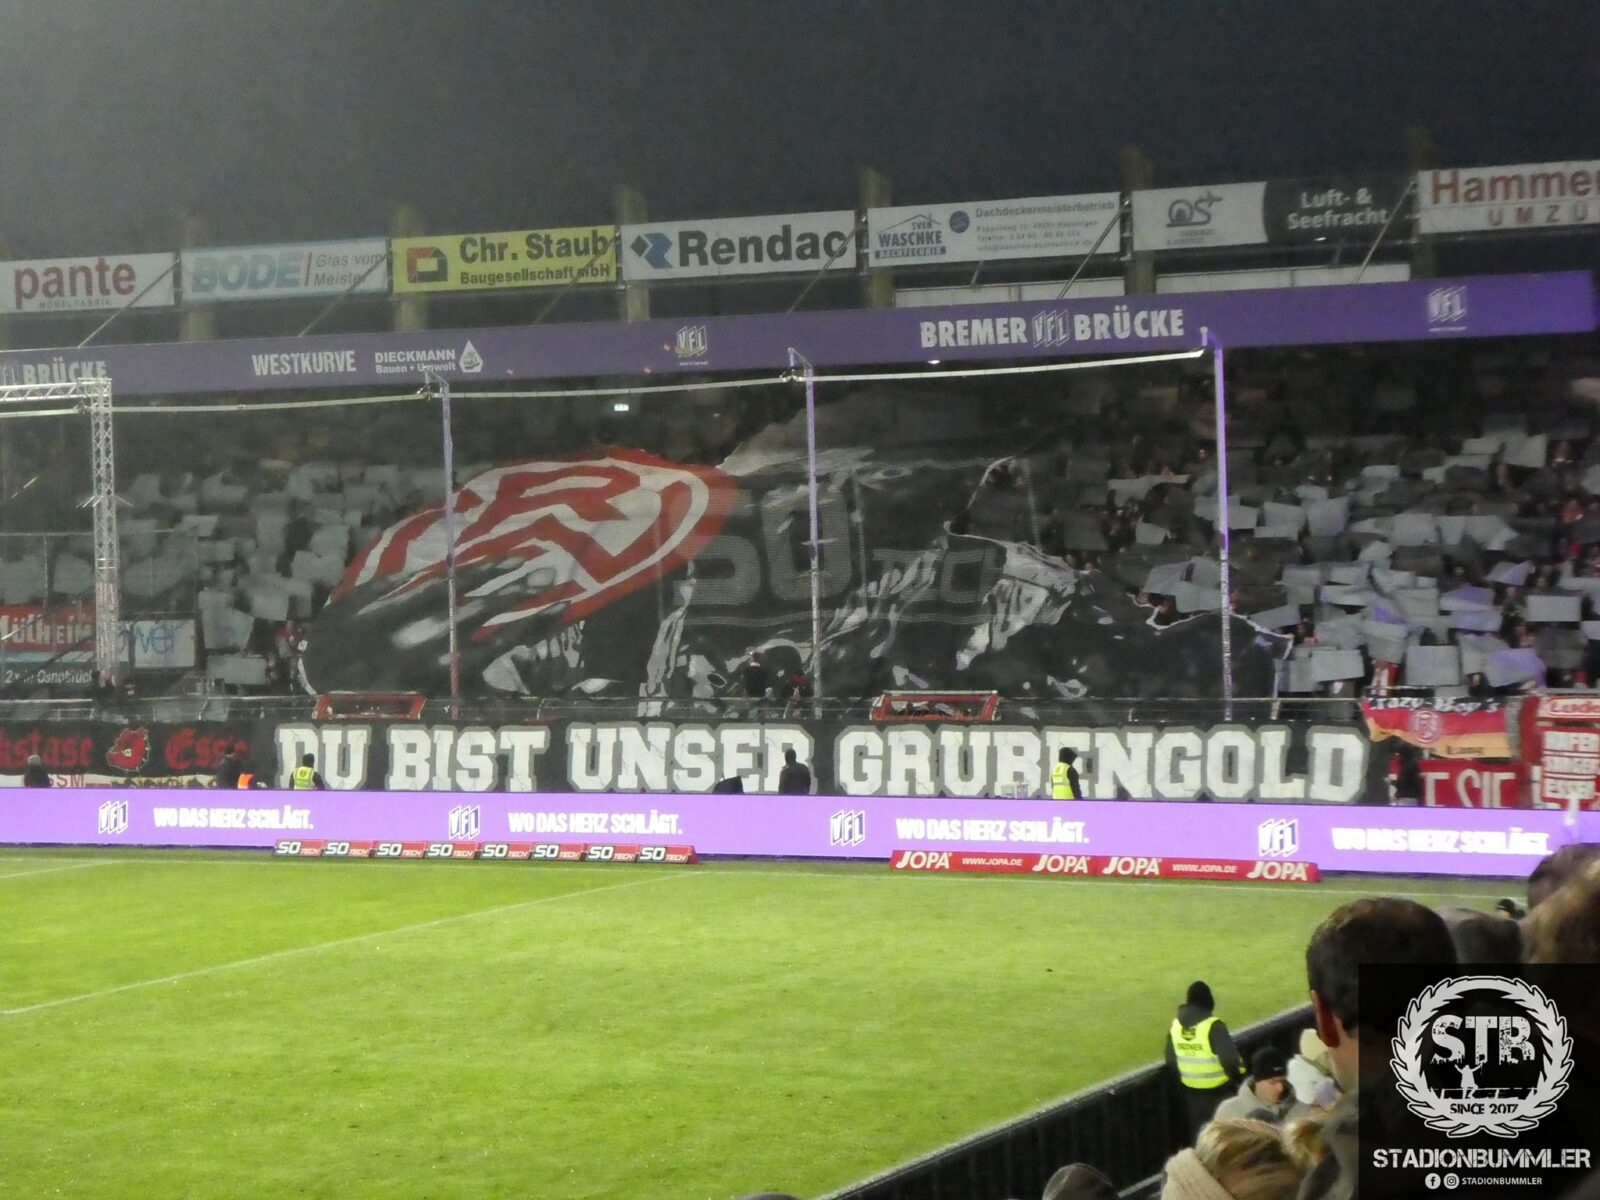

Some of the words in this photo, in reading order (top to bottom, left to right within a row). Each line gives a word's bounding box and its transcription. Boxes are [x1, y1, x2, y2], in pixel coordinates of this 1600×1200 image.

[1287, 207, 1389, 230] Seefracht
[460, 236, 518, 264] Chr.
[526, 230, 608, 260] Staub
[679, 223, 848, 267] Rendac
[879, 231, 943, 247] WASCHKE
[316, 254, 349, 268] Glas
[15, 257, 136, 310] pante
[191, 255, 300, 294] BODE
[460, 265, 574, 285] Baugesellschaft
[920, 317, 1028, 348] BREMER
[1073, 304, 1185, 342] BRÜCKE
[252, 351, 356, 376] WESTKURVE
[375, 349, 456, 363] DIECKMANN
[376, 364, 407, 374] Bauen
[417, 361, 456, 372] Umwelt
[277, 727, 370, 790] DU
[387, 728, 548, 792] BIST
[568, 725, 813, 793] UNSER
[836, 728, 1366, 802] GRUBENGOLD
[153, 808, 177, 827] WO
[179, 808, 208, 827] DAS
[210, 808, 245, 828] HERZ
[247, 805, 314, 829] SCHLÄGT.
[508, 813, 533, 832] WO
[536, 813, 568, 832] DAS
[570, 813, 608, 833] HERZ
[610, 809, 683, 834] SCHLÄGT.
[896, 818, 925, 839] WO
[926, 819, 962, 840] DAS
[963, 820, 1007, 841] HERZ
[1009, 817, 1089, 843] SCHLÄGT.
[896, 852, 950, 869] JOPA
[962, 857, 1022, 866] WWW.JOPA.DE
[1032, 854, 1088, 873] JOPA
[1103, 857, 1160, 875] JOPA
[1172, 863, 1237, 874] WWW.JOPA.DE
[1247, 861, 1308, 881] JOPA
